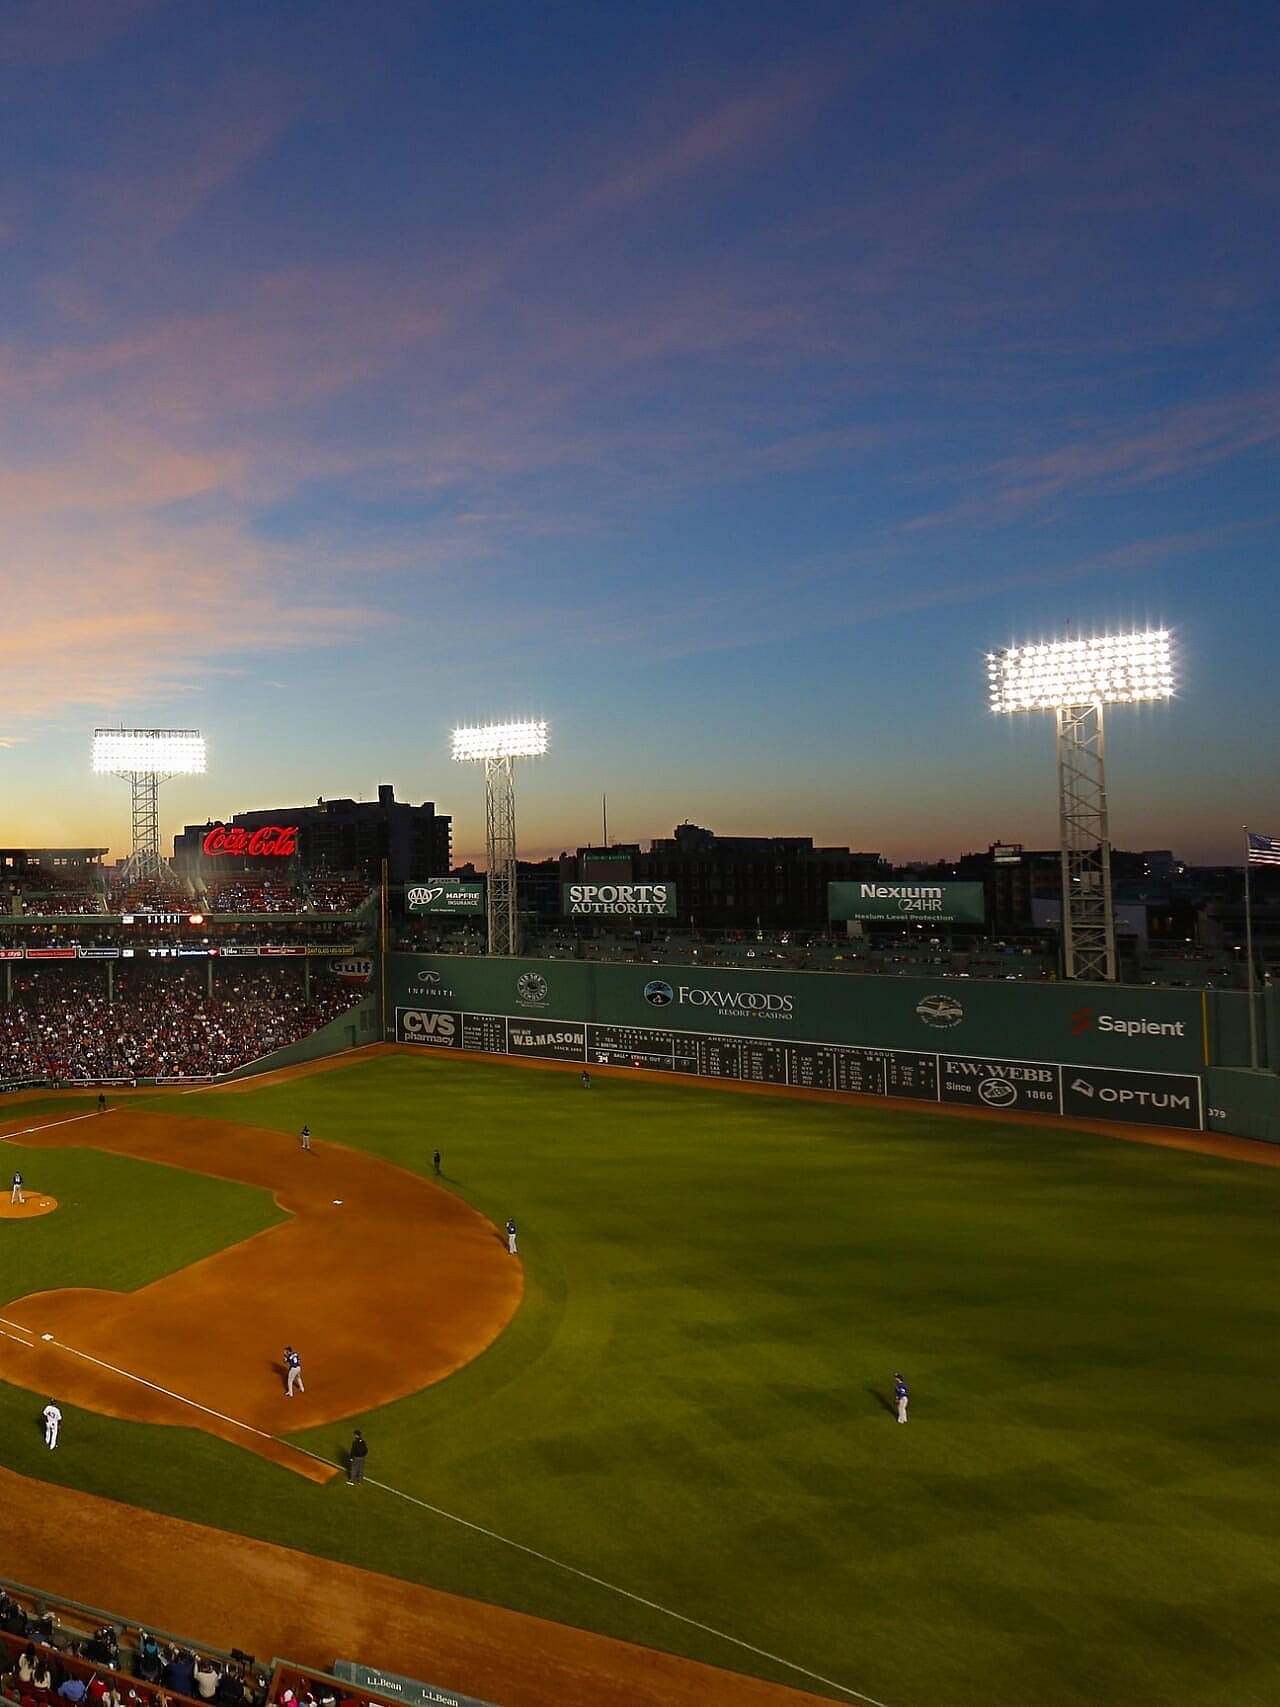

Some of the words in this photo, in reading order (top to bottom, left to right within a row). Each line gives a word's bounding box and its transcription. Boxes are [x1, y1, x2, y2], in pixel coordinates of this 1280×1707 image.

[203, 826, 298, 856] Coca-Cola
[409, 888, 432, 904] AAA
[569, 885, 667, 904] SPORTS
[860, 884, 942, 898] Nexium
[570, 902, 667, 915] AUTHORITY
[903, 899, 942, 911] 24HR
[331, 959, 372, 974] Gulf
[408, 986, 452, 998] INFINITI
[679, 986, 793, 1012] FOXWOODS
[718, 1008, 750, 1017] RESORT
[758, 1011, 793, 1020] CASINO
[403, 1011, 456, 1036] CVS
[1098, 1015, 1184, 1037] Sapient
[404, 1031, 455, 1047] pharmacy
[512, 1032, 584, 1046] W.B.MASON
[707, 1036, 742, 1044] AMERICAN
[824, 1047, 861, 1055] NATIONAL
[945, 1061, 983, 1077] F.W.
[986, 1063, 1053, 1083] WEBB
[946, 1081, 971, 1093] Since
[1026, 1089, 1054, 1101] 1866
[1098, 1088, 1191, 1110] OPTUM
[1208, 1107, 1226, 1119] 379
[367, 1676, 402, 1692] L.L.Bean
[422, 1688, 459, 1707] L.L.Bean
